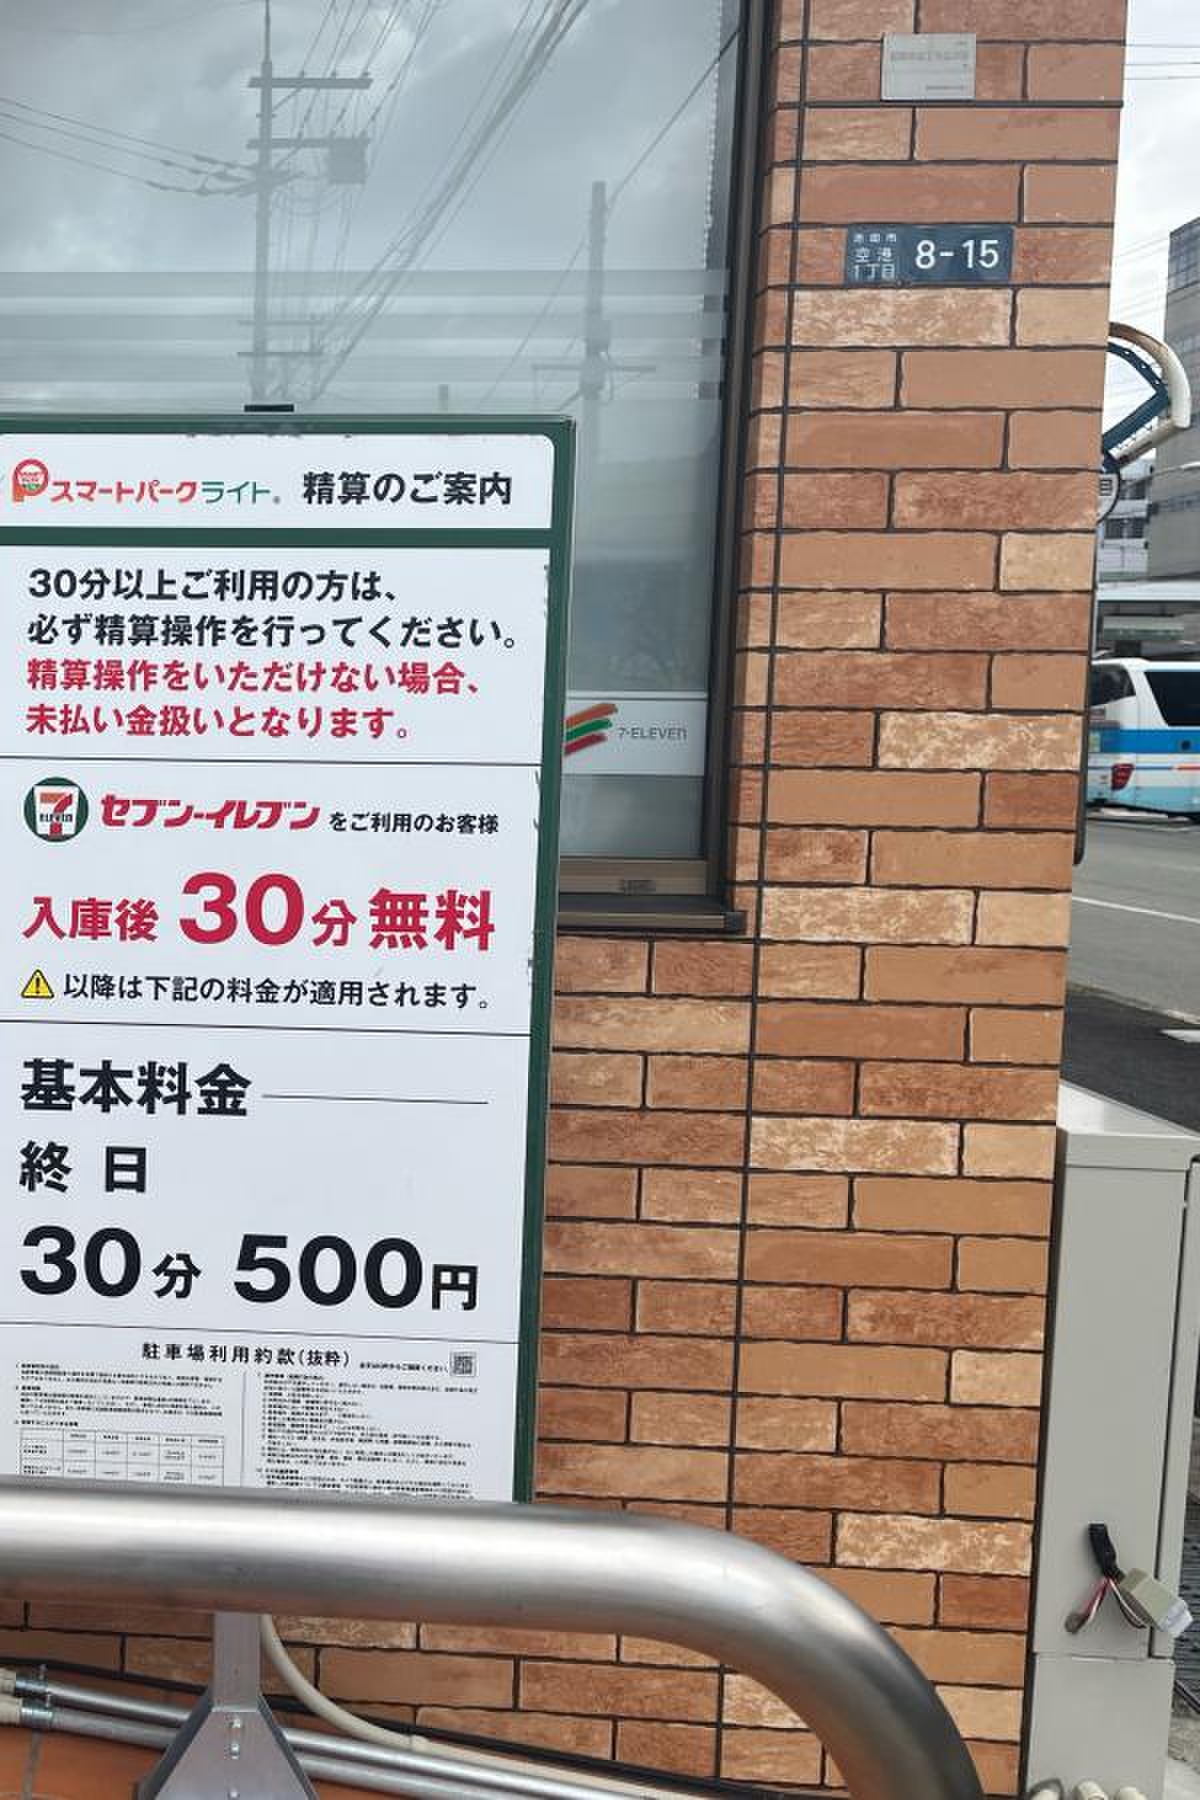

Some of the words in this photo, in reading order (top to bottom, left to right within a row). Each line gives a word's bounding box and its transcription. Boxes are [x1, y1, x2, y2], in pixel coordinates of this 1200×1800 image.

[915, 240, 999, 269] 8-15
[302, 471, 513, 506] 精算のご案内
[28, 567, 397, 603] 30分以上ご利用の方は、
[27, 613, 516, 650] 必ず精算操作を行ってください。
[26, 658, 479, 695] 精算操作をいただけない場合、
[25, 704, 408, 740] 未払い金扱いとなります。
[330, 811, 499, 835] をご利用のお客様
[22, 895, 159, 943] 入庫後
[369, 888, 496, 951] 無料
[63, 973, 489, 1010] 以降は下記の料金が適用されます。
[21, 1057, 252, 1117] 基本料金
[19, 1139, 148, 1194] 終日
[234, 1233, 479, 1311] 500円
